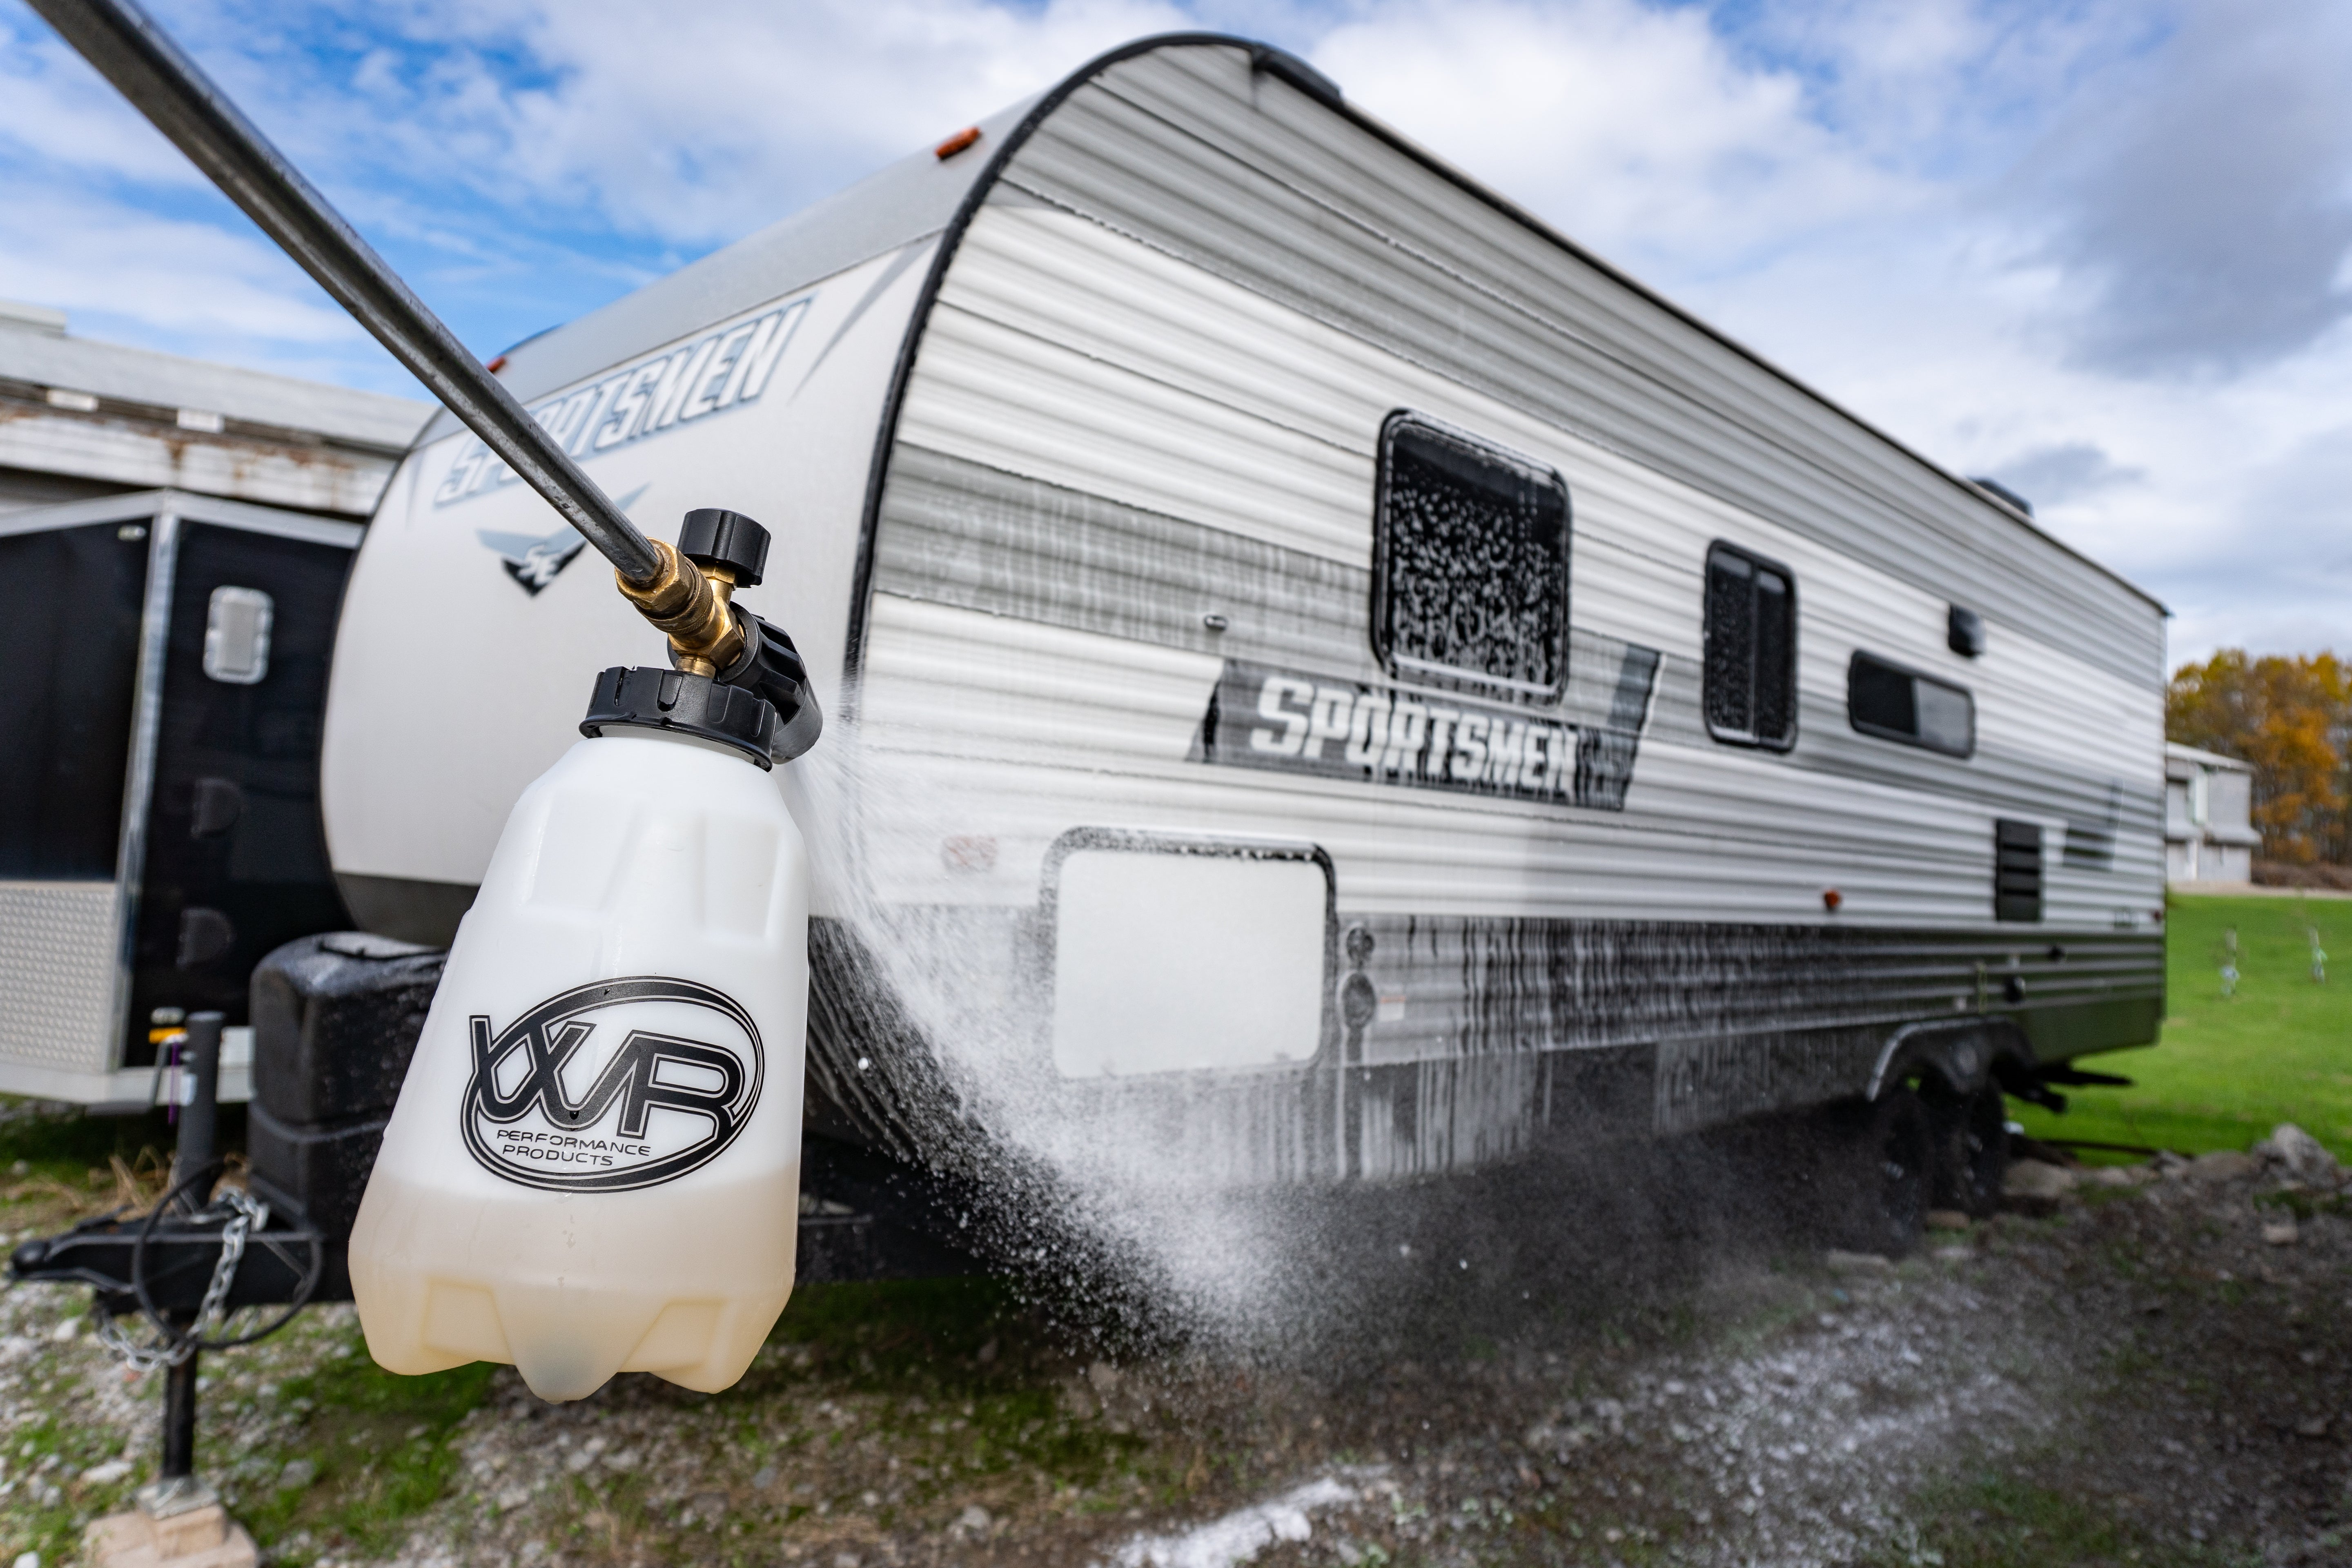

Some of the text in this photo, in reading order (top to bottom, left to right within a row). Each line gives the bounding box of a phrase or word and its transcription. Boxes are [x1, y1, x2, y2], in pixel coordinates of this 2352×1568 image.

[1250, 675, 1578, 793] SPORTSMEN
[497, 1129, 651, 1156] PERFORMANCE
[502, 1145, 614, 1166] PRODUCTS
